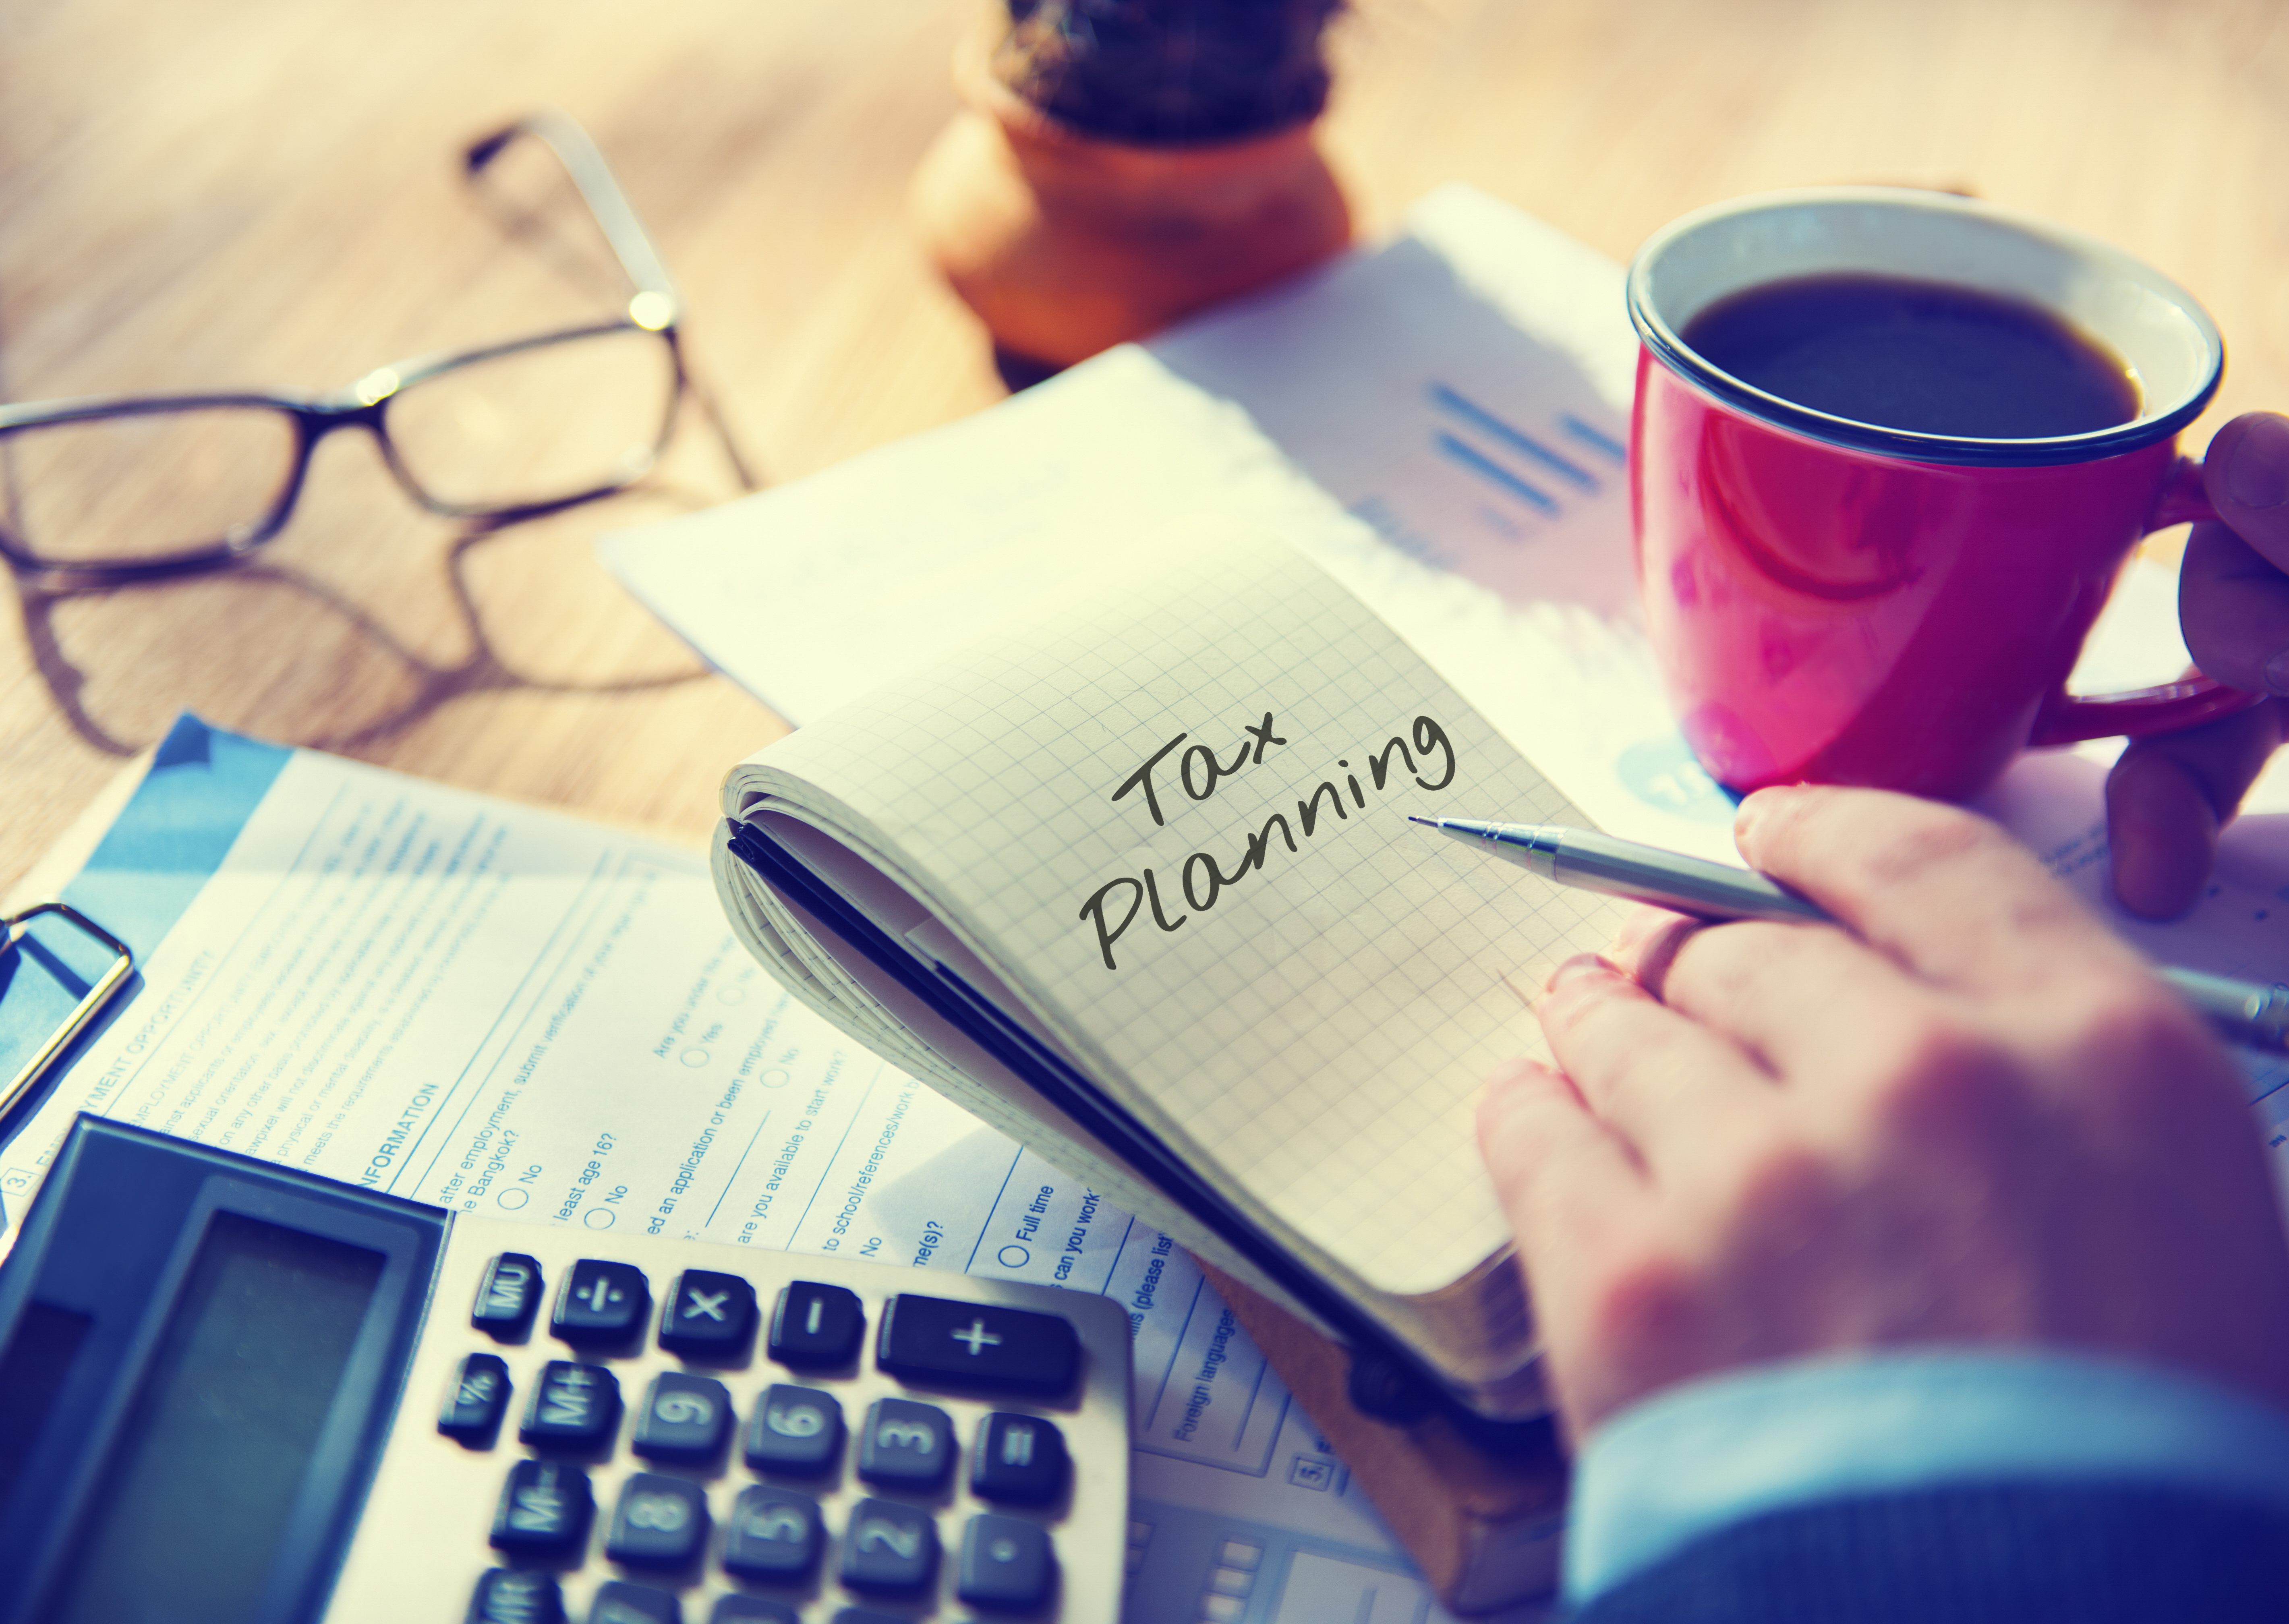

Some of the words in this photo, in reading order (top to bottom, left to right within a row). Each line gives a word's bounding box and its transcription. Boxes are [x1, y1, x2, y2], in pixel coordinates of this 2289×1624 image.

[1112, 712, 1286, 826] Tax
[738, 1019, 777, 1076] employed
[778, 1048, 800, 1065] No
[180, 1058, 225, 1108] applicants
[277, 1096, 293, 1112] will
[289, 1077, 308, 1094] not
[303, 1132, 333, 1165] meets
[326, 1112, 346, 1129] the
[342, 1045, 394, 1110] requirements
[716, 1079, 744, 1109] been
[186, 1108, 219, 1146] sexual
[219, 1131, 236, 1145] on
[231, 1108, 253, 1129] any
[247, 1080, 272, 1107] other
[277, 1113, 314, 1157] physical
[309, 1099, 322, 1111] or
[319, 1063, 349, 1098] mental
[439, 1172, 465, 1204] after
[461, 1090, 522, 1169] employment,
[514, 1044, 547, 1085] submit
[711, 1110, 725, 1125] or
[468, 1130, 519, 1196] Bangkok?
[670, 1128, 717, 1195] application
[737, 1222, 758, 1244] are
[751, 1194, 773, 1219] you
[766, 1134, 804, 1191] available
[795, 1119, 812, 1131] to
[806, 1089, 828, 1116] start
[822, 1050, 843, 1085] work?
[822, 1238, 840, 1251] to
[833, 1093, 909, 1235] school/references/work
[518, 1165, 543, 1184] No
[553, 1187, 586, 1221] least
[578, 1160, 601, 1185] age
[592, 1133, 617, 1156] 16?
[604, 1184, 628, 1205] No
[659, 1197, 677, 1214] an
[1015, 1215, 1041, 1242] Full
[1029, 1185, 1054, 1214] time
[859, 1237, 882, 1257] No
[1054, 1255, 1075, 1280] can
[1065, 1226, 1087, 1254] you
[1077, 1188, 1101, 1224] work
[487, 1263, 531, 1309] MU
[1132, 1258, 1165, 1309] (please
[1171, 1385, 1211, 1442] Foreign
[1197, 1305, 1240, 1382] languages
[653, 1390, 715, 1426] 9
[766, 1402, 827, 1438] 6
[877, 1419, 935, 1456] 3
[626, 1491, 689, 1532] 8
[854, 1518, 922, 1561] 2
